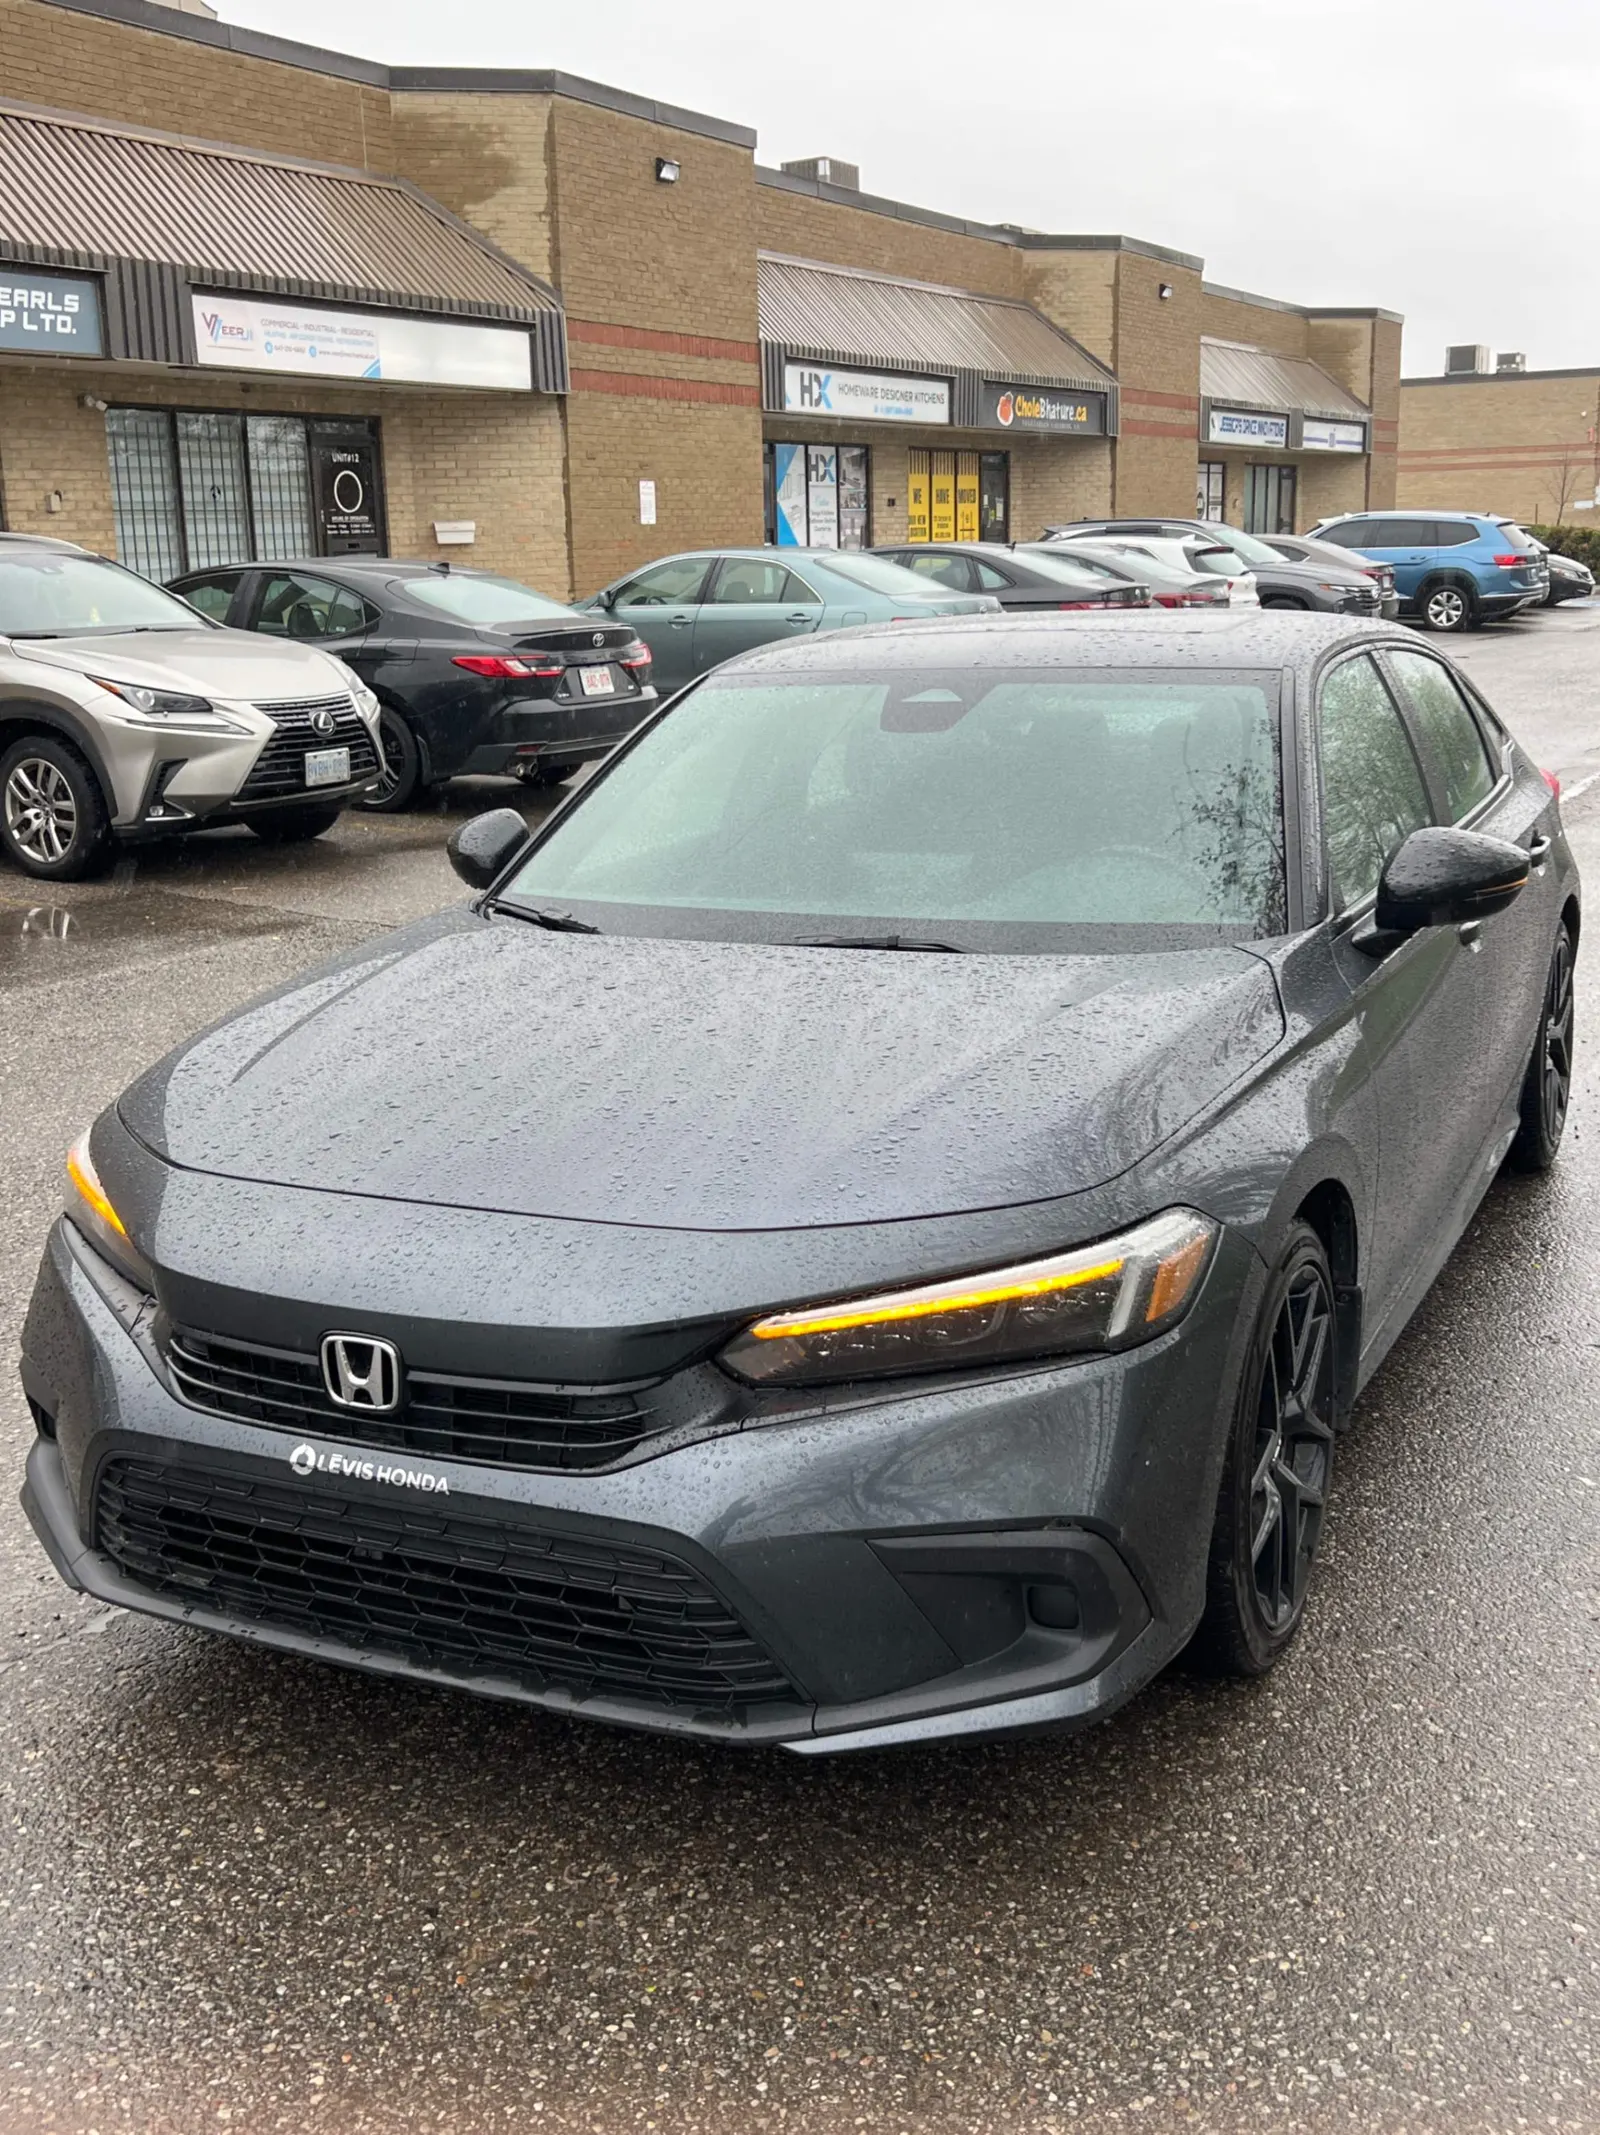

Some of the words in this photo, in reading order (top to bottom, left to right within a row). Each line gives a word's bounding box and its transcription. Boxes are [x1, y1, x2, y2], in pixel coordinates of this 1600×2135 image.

[22, 311, 77, 335] LTD.
[838, 383, 879, 400] HOMEWARE
[880, 388, 914, 403] DESIGNER
[914, 392, 945, 405] KITCHENS
[1015, 395, 1088, 422] CholeBhature.ca
[376, 1465, 451, 1496] HONDA
